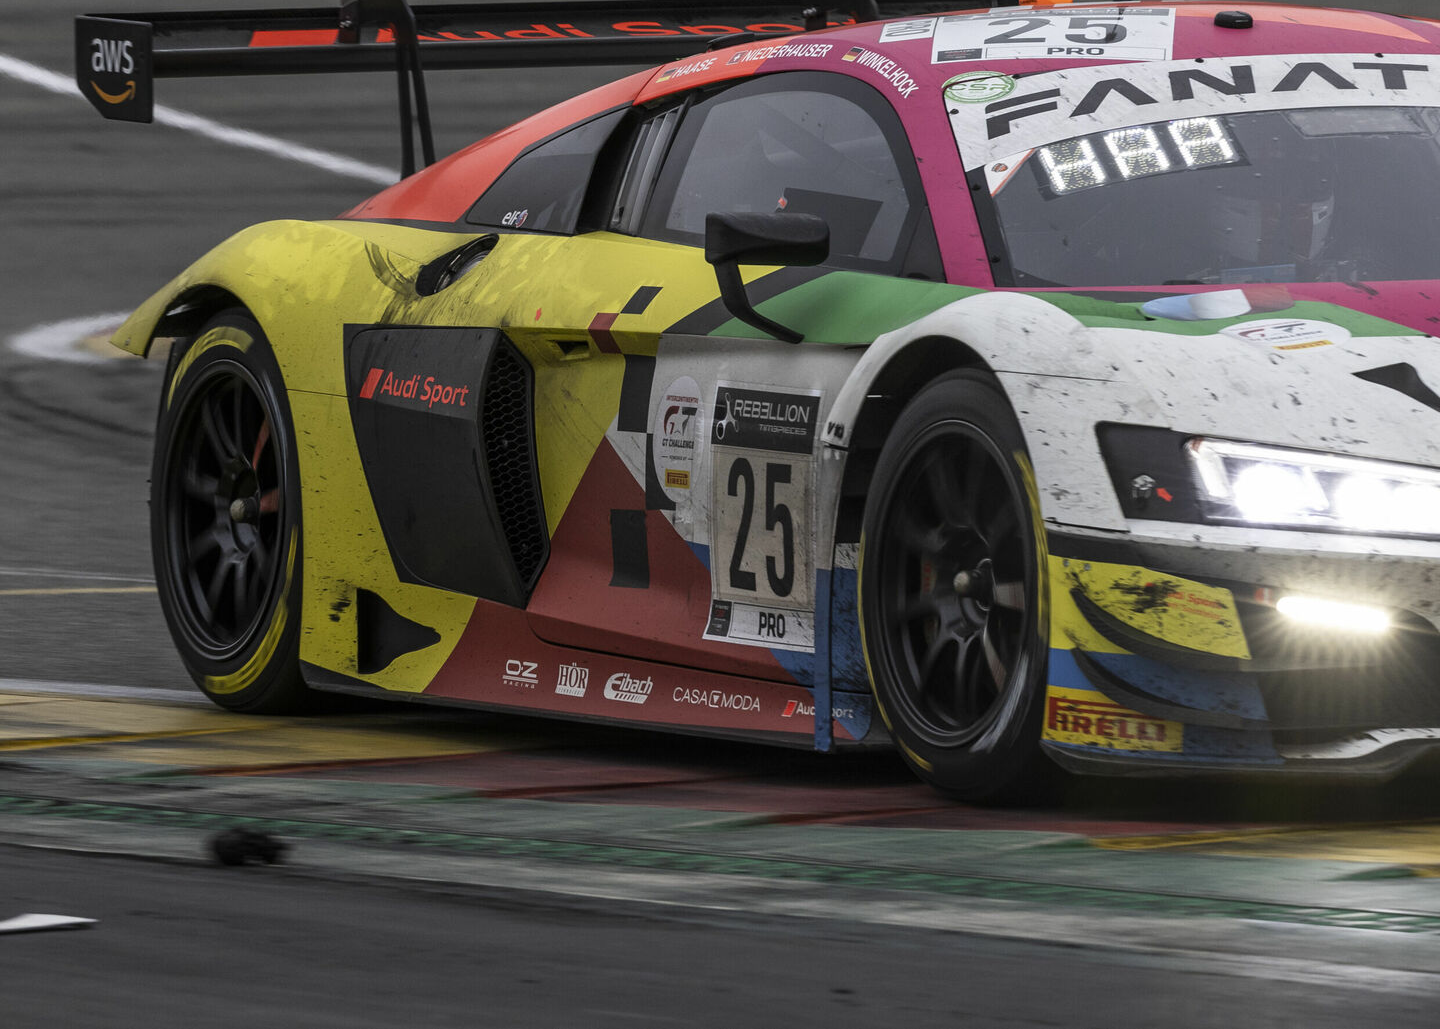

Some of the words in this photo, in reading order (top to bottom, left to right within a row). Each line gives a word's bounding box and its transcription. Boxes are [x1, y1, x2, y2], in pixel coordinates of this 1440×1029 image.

[984, 17, 1128, 45] 25
[90, 38, 135, 74] aws
[742, 44, 834, 63] NIEDERHAUSER
[1047, 47, 1105, 56] PRO
[671, 57, 718, 79] HAASE
[856, 49, 921, 100] WINKELHOCK
[380, 372, 420, 399] Audi
[420, 376, 469, 409] Sport
[728, 457, 795, 598] 25
[758, 612, 786, 639] PRO
[558, 662, 587, 689] HÖR
[604, 672, 653, 700] Eibach
[1048, 696, 1167, 742] PIRELLI
